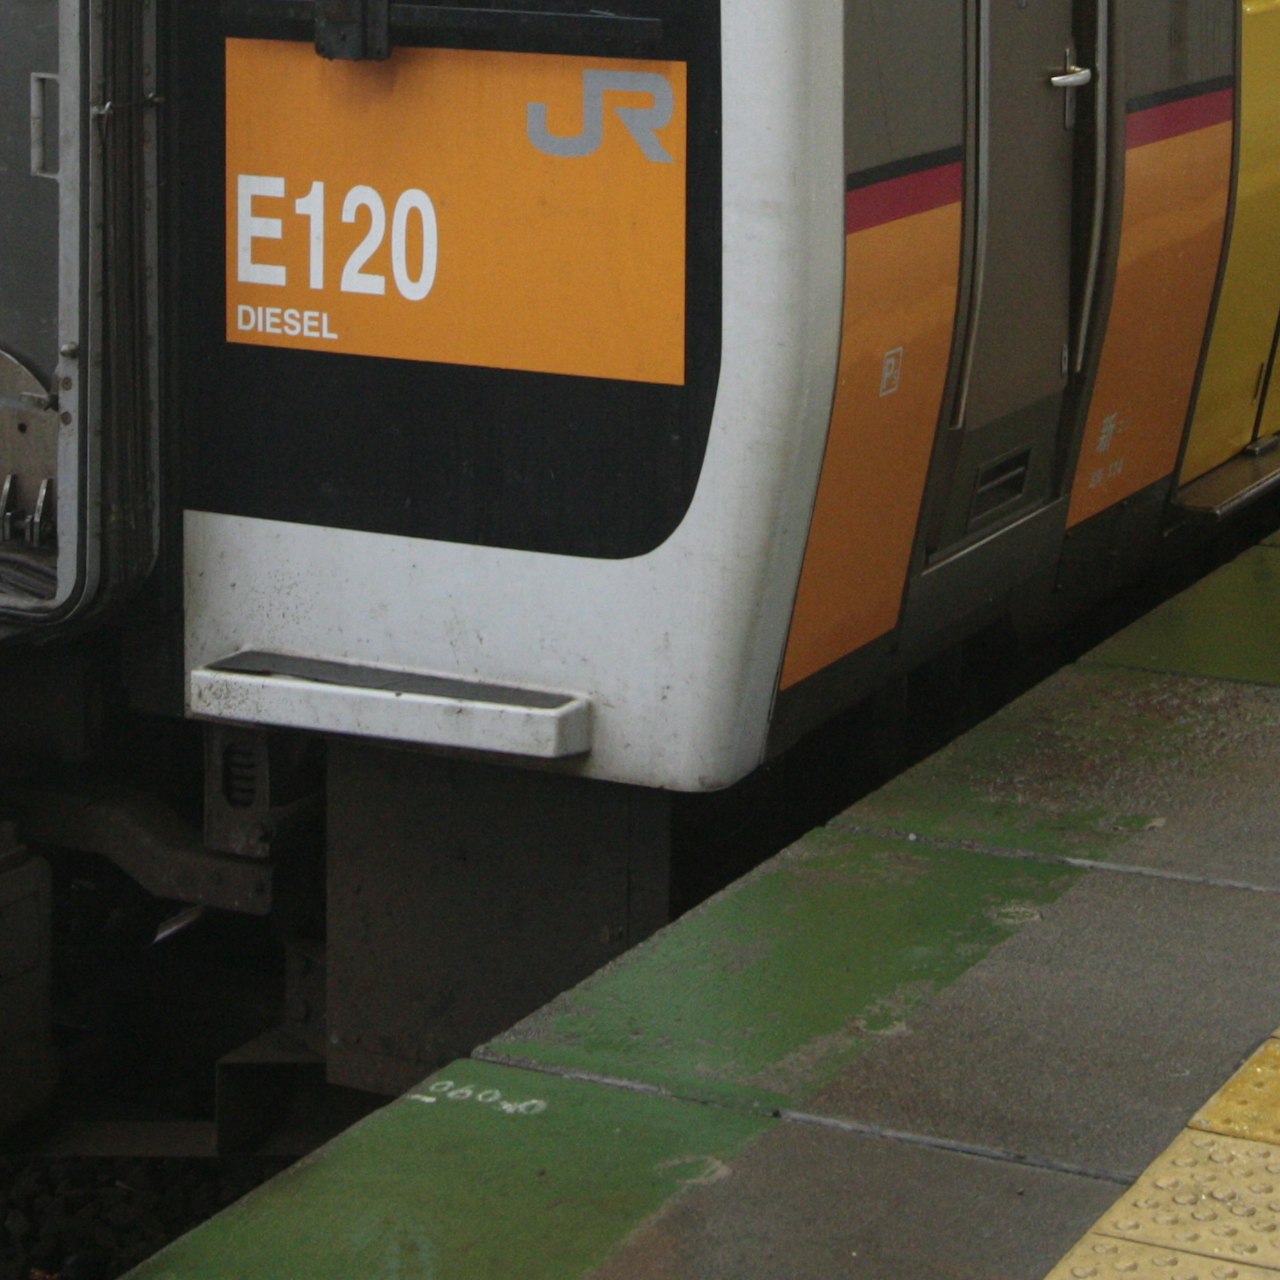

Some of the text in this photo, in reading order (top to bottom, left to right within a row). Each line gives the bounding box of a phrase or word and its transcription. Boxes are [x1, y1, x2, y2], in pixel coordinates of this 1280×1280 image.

[526, 68, 675, 164] JR
[237, 173, 439, 302] E120
[236, 304, 339, 341] DIESEL
